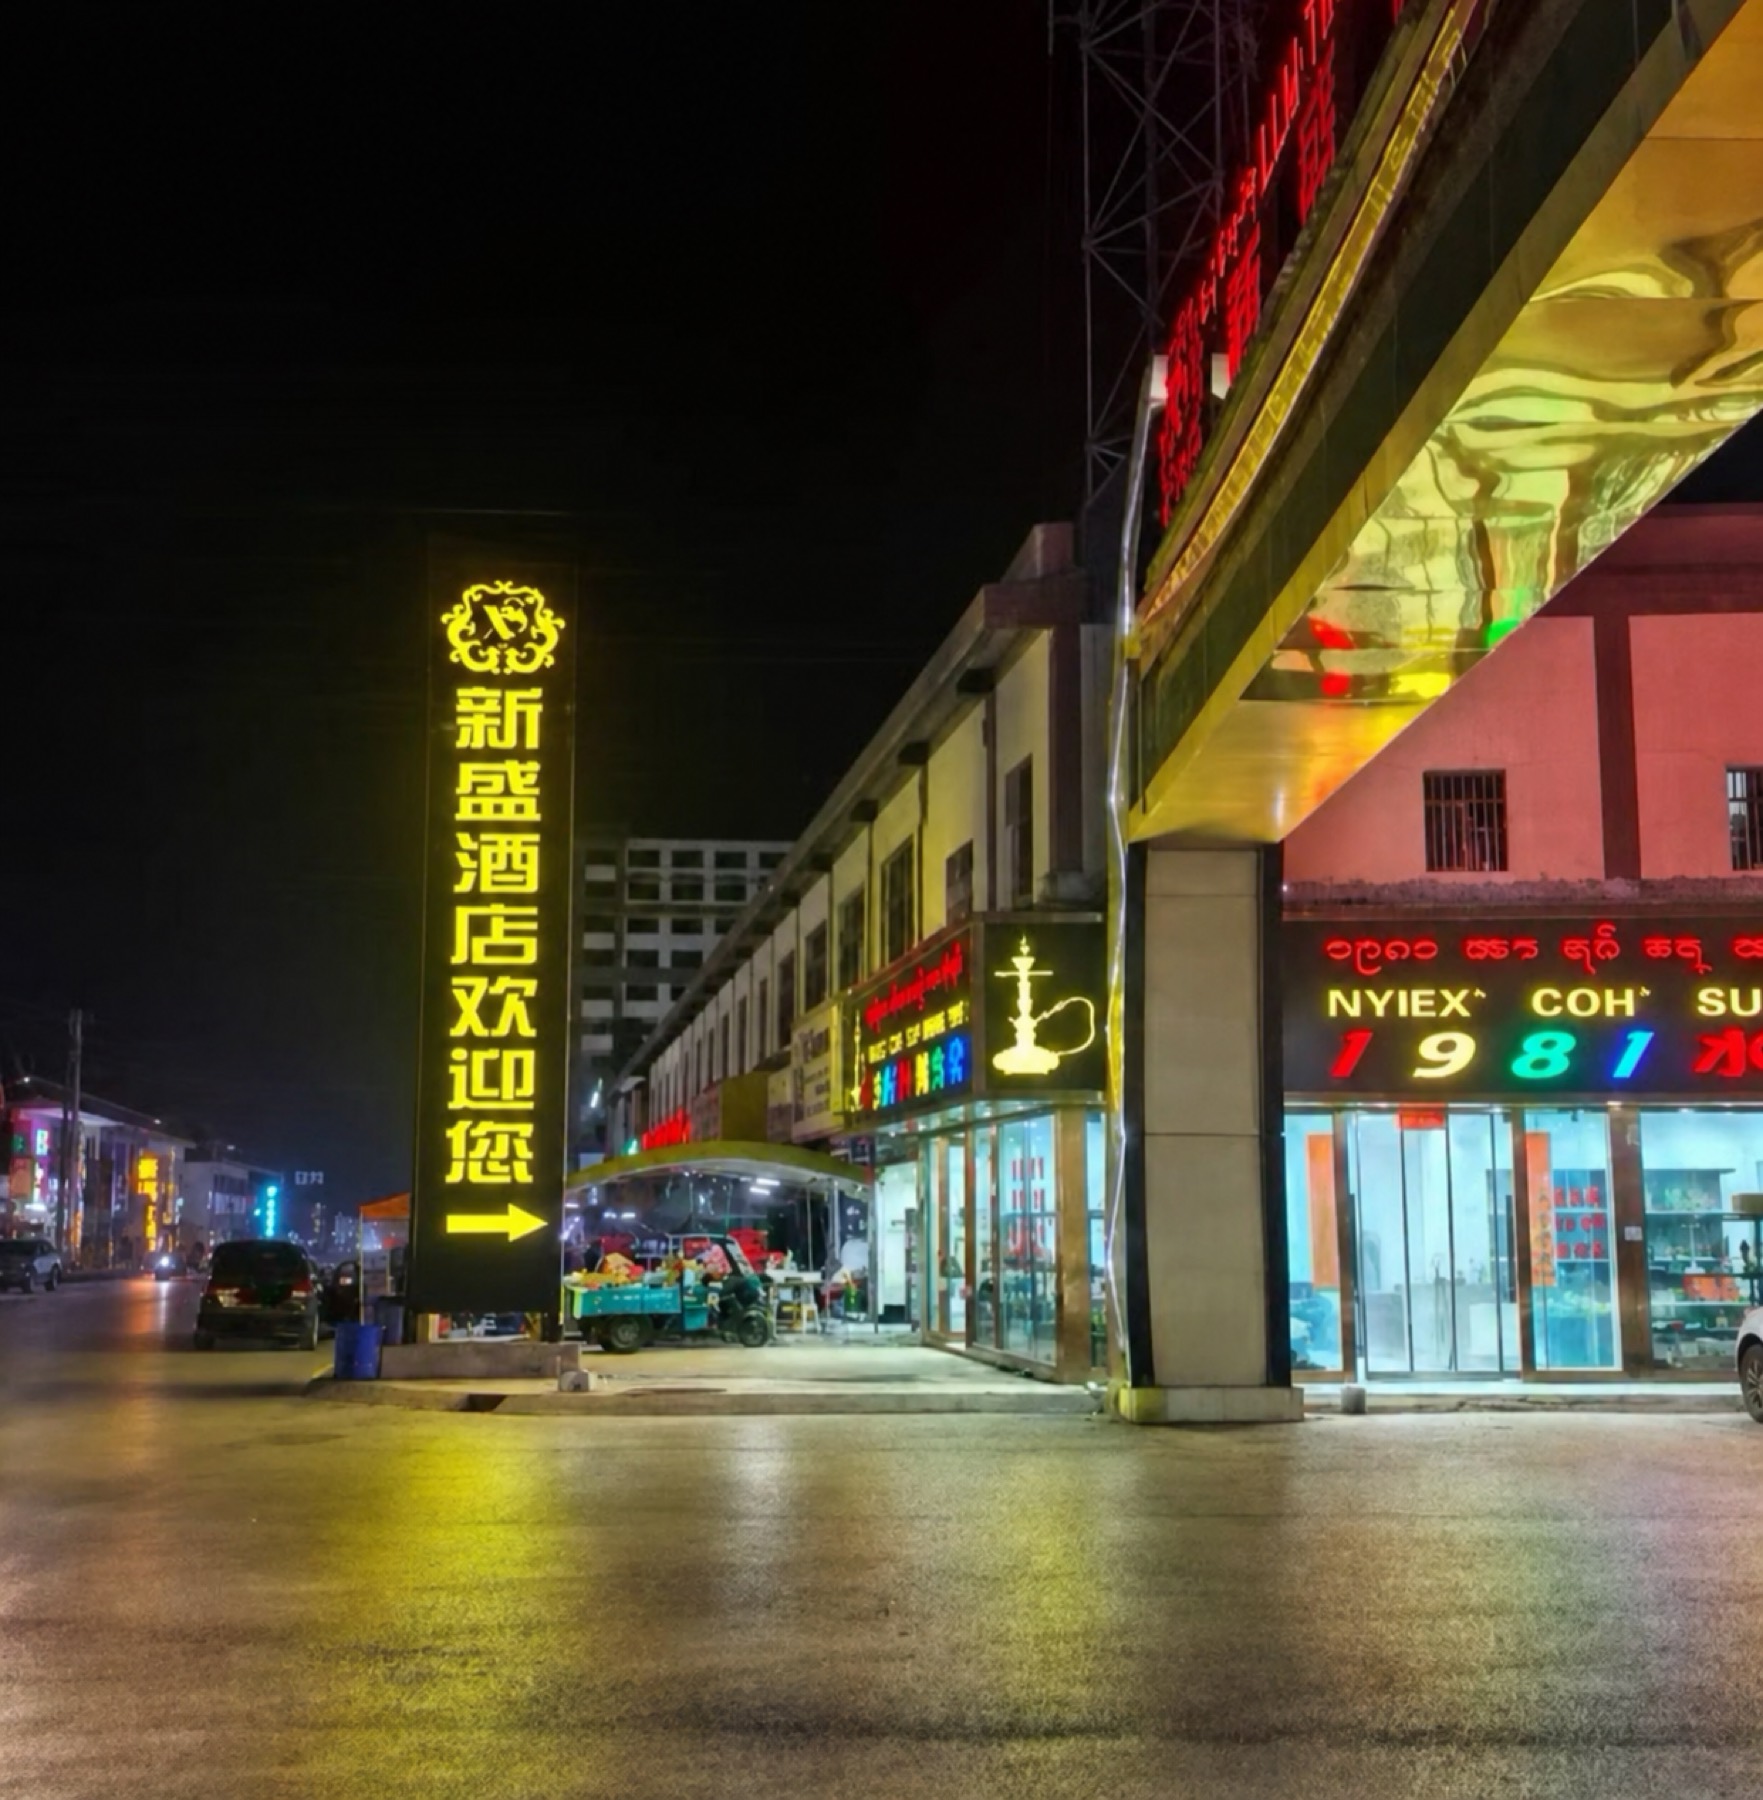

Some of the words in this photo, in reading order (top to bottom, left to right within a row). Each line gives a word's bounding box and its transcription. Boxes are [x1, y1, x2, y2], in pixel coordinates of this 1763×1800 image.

[445, 687, 543, 1185] 新盛酒店欢迎您
